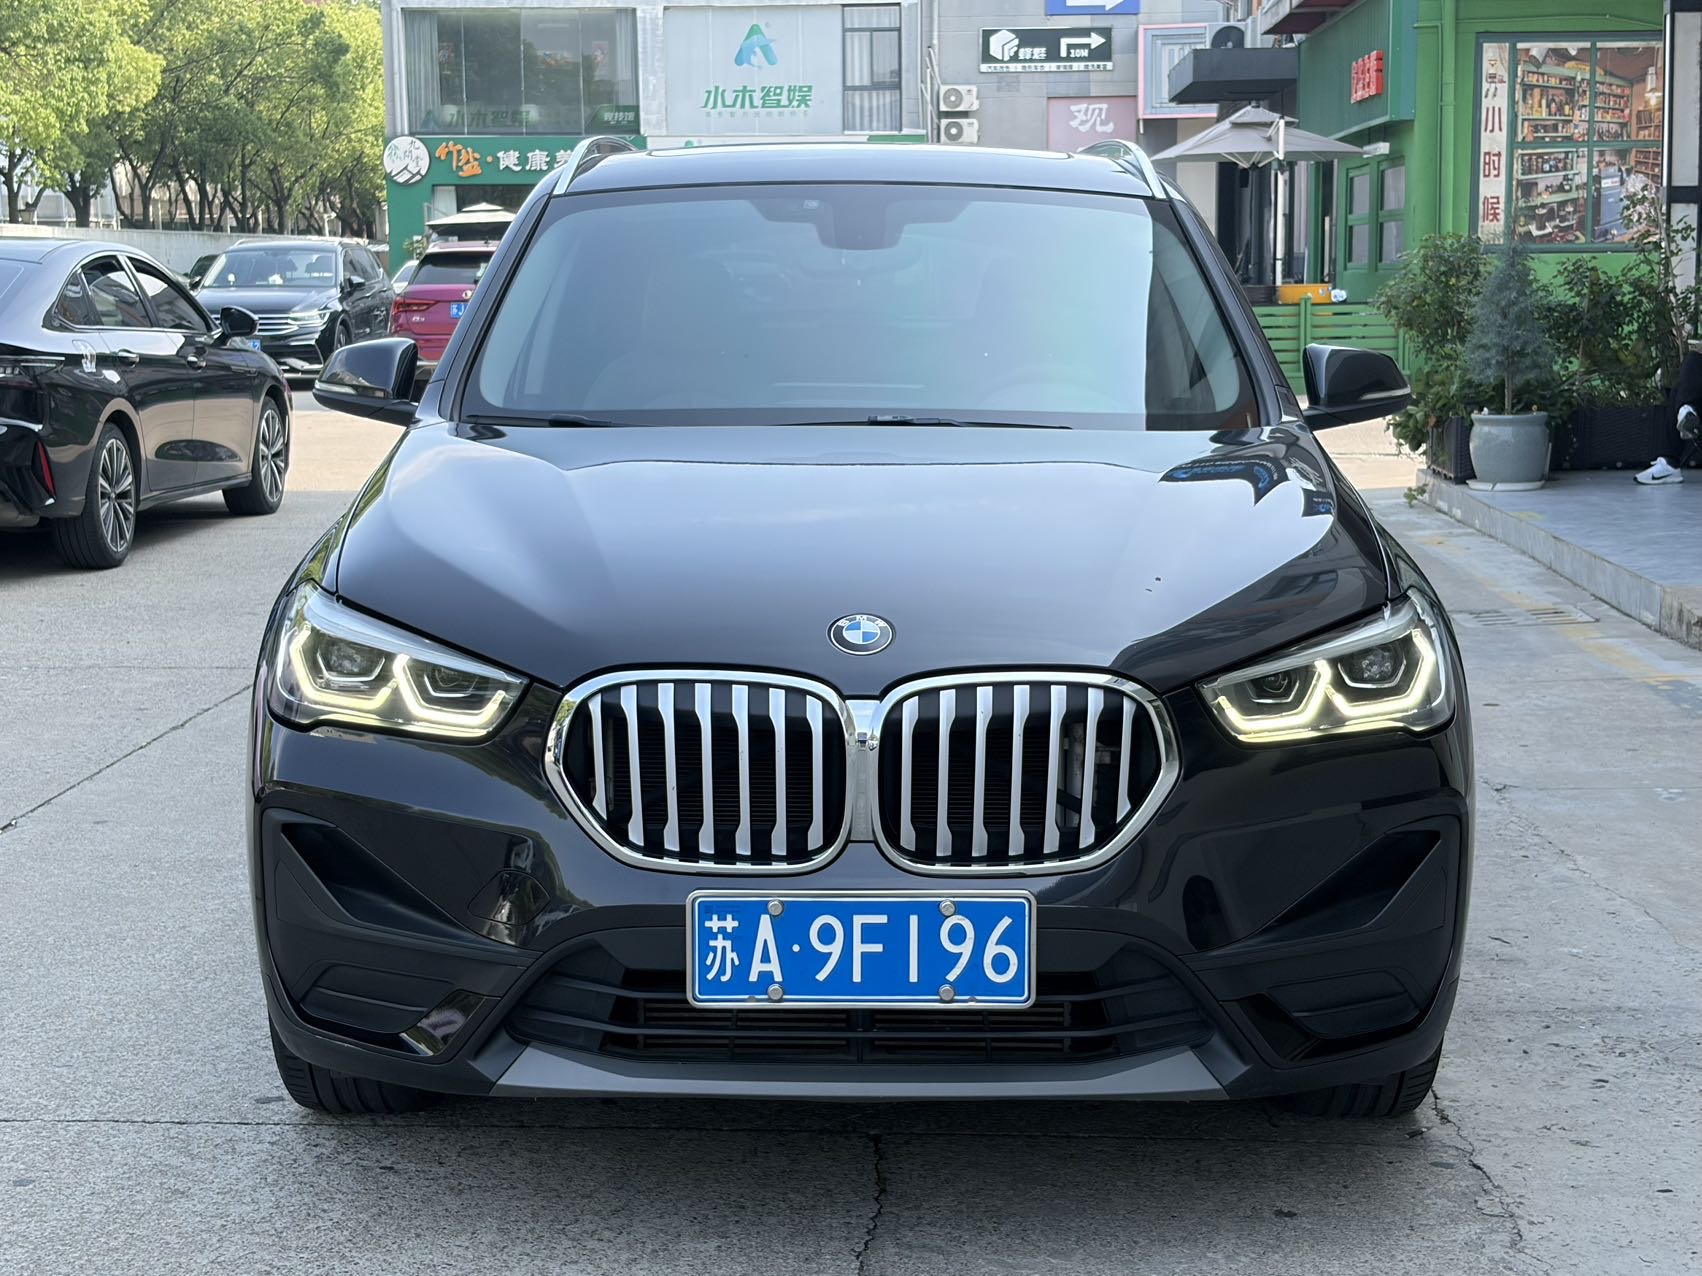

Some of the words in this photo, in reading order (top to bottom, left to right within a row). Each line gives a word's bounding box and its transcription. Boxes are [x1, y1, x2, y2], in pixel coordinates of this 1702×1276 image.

[701, 85, 813, 109] 水木智娱
[1482, 106, 1502, 222] 小时候
